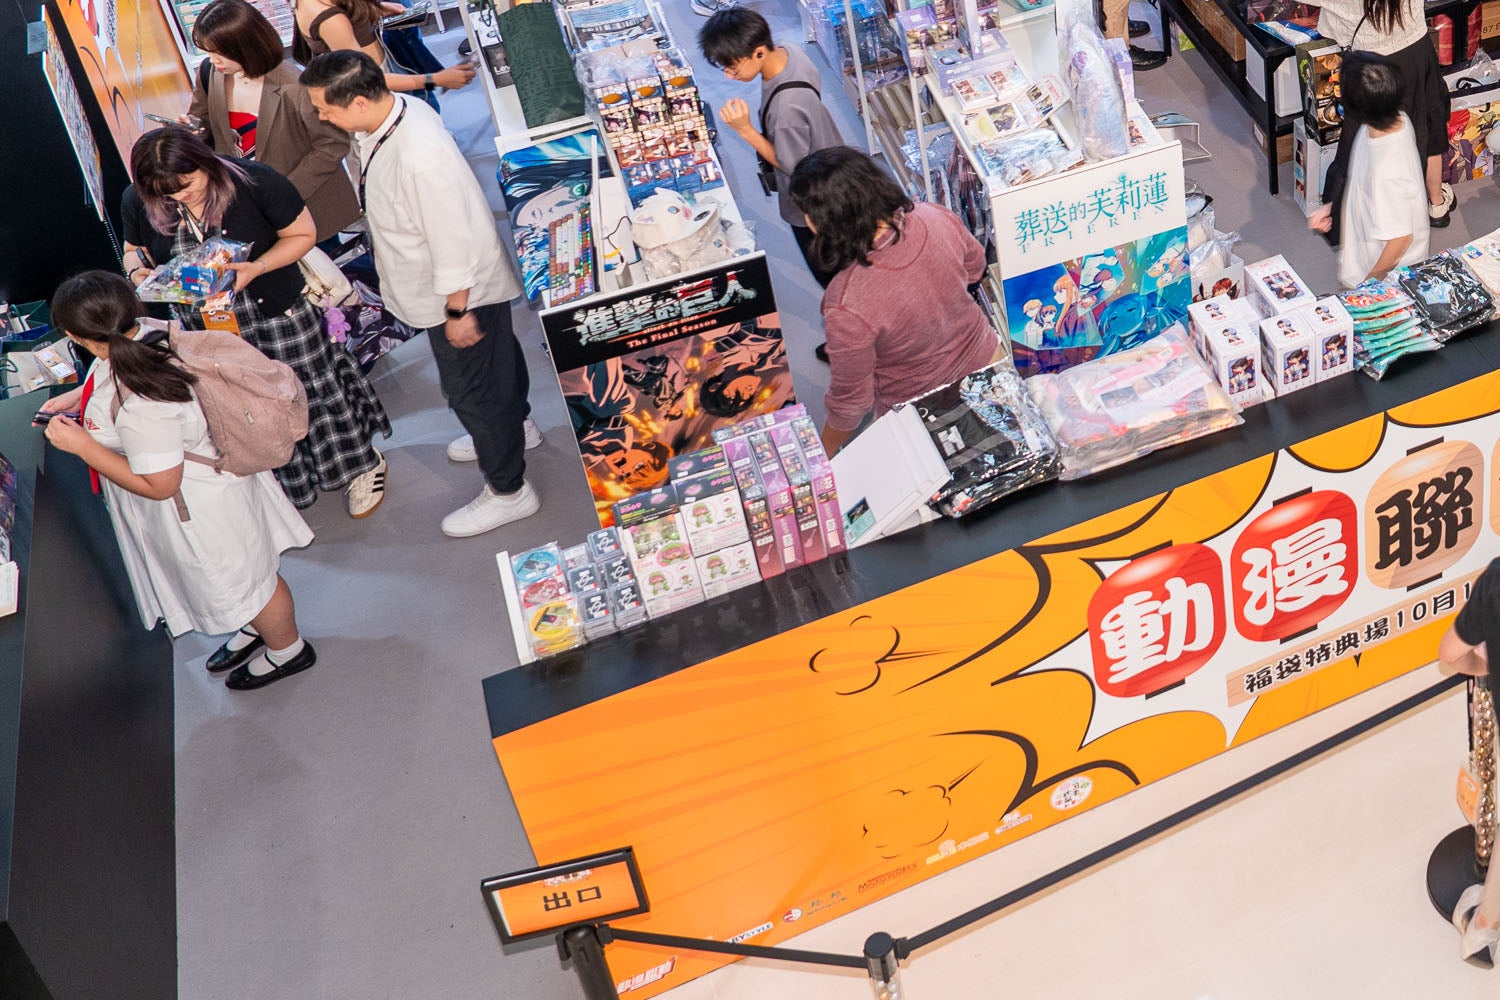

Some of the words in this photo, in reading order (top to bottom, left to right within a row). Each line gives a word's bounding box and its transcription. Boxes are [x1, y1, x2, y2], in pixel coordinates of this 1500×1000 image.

[1014, 172, 1169, 248] 葬送的芙莉蓮
[626, 338, 649, 349] The
[651, 329, 679, 343] Final
[681, 318, 718, 335] Season
[543, 886, 602, 912] 出口
